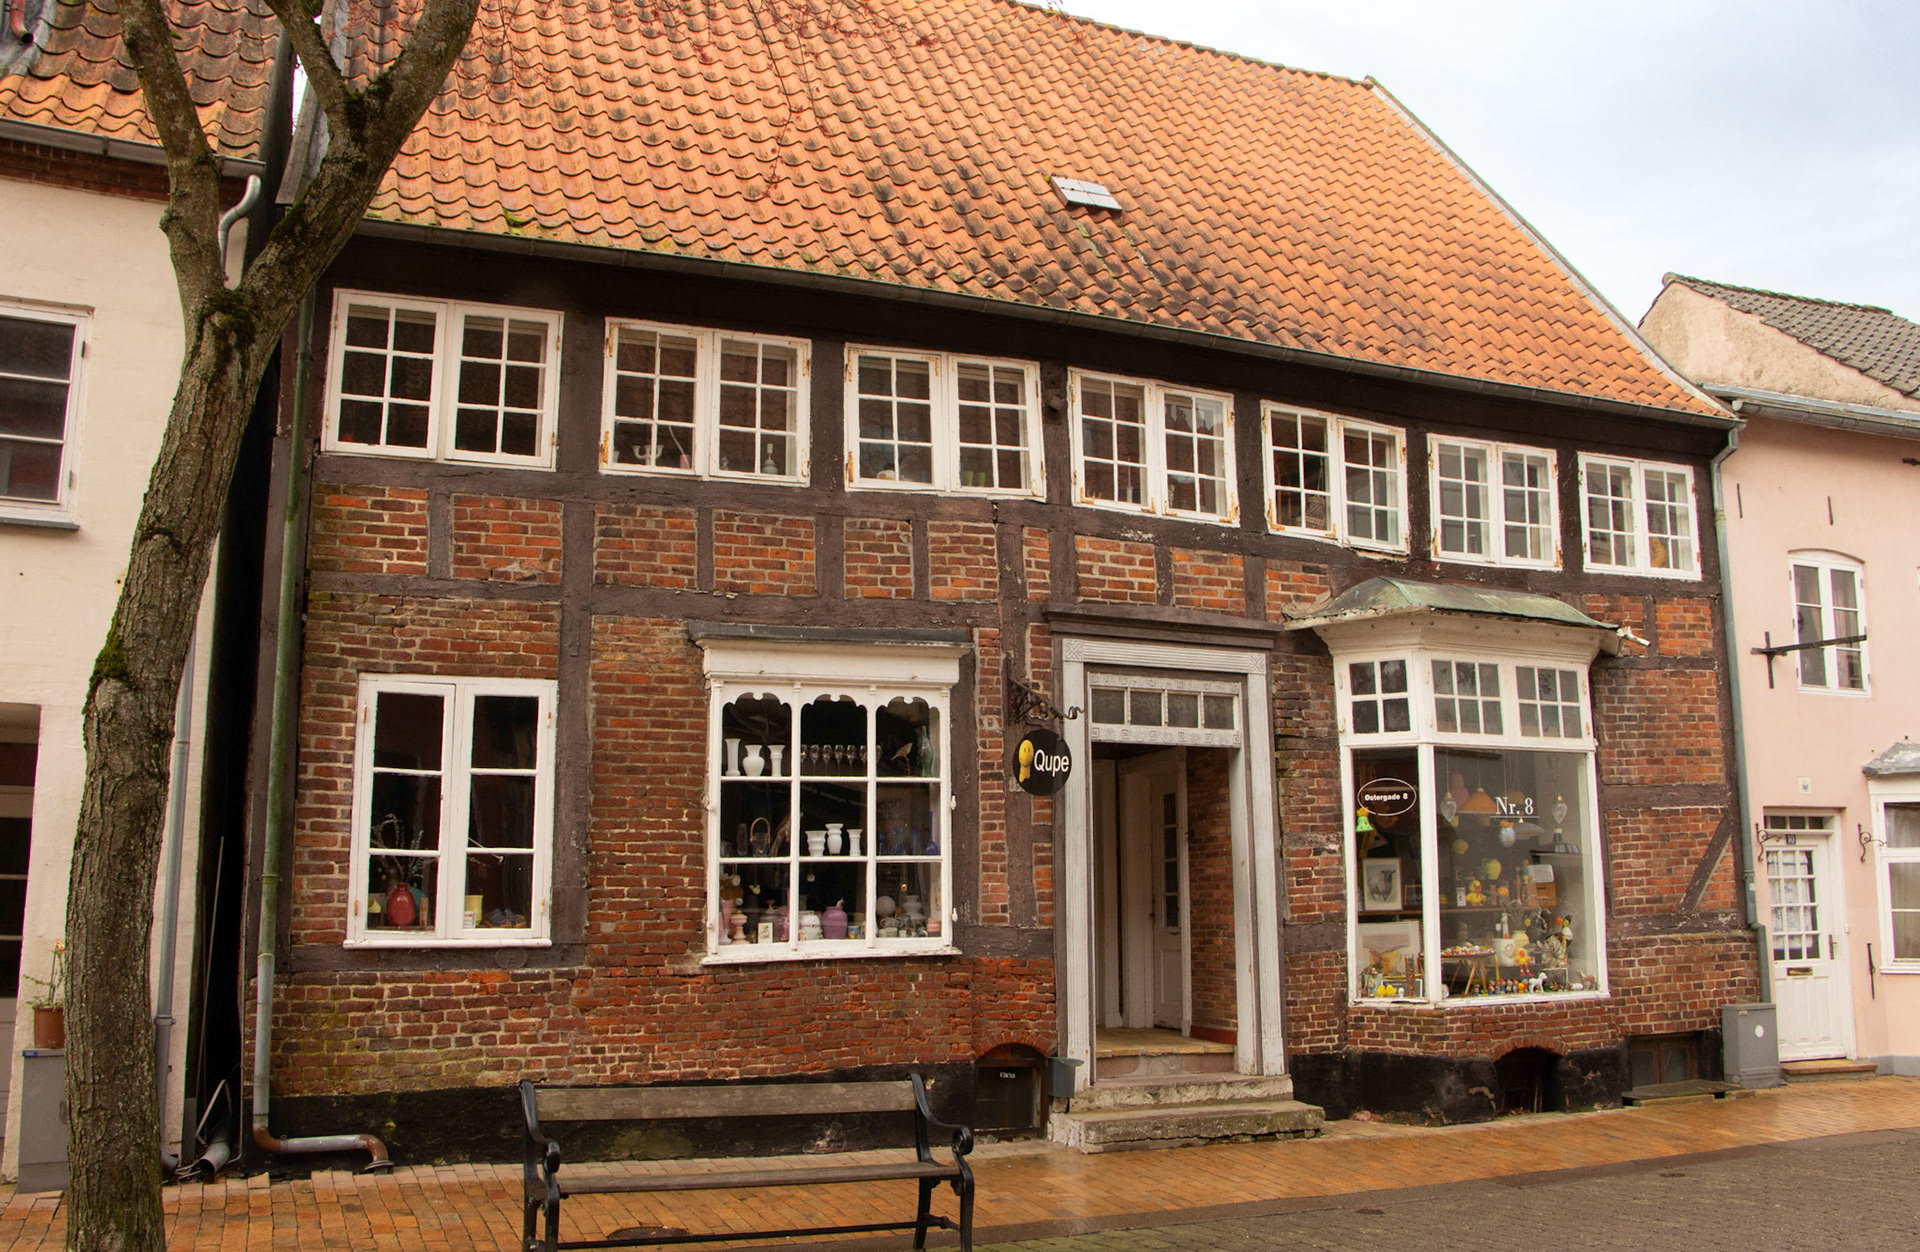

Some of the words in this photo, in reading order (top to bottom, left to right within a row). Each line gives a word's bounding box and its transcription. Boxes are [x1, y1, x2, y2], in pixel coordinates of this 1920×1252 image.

[1034, 749, 1069, 777] Qupe
[1495, 796, 1520, 815] Nr.
[1524, 797, 1534, 815] 8
